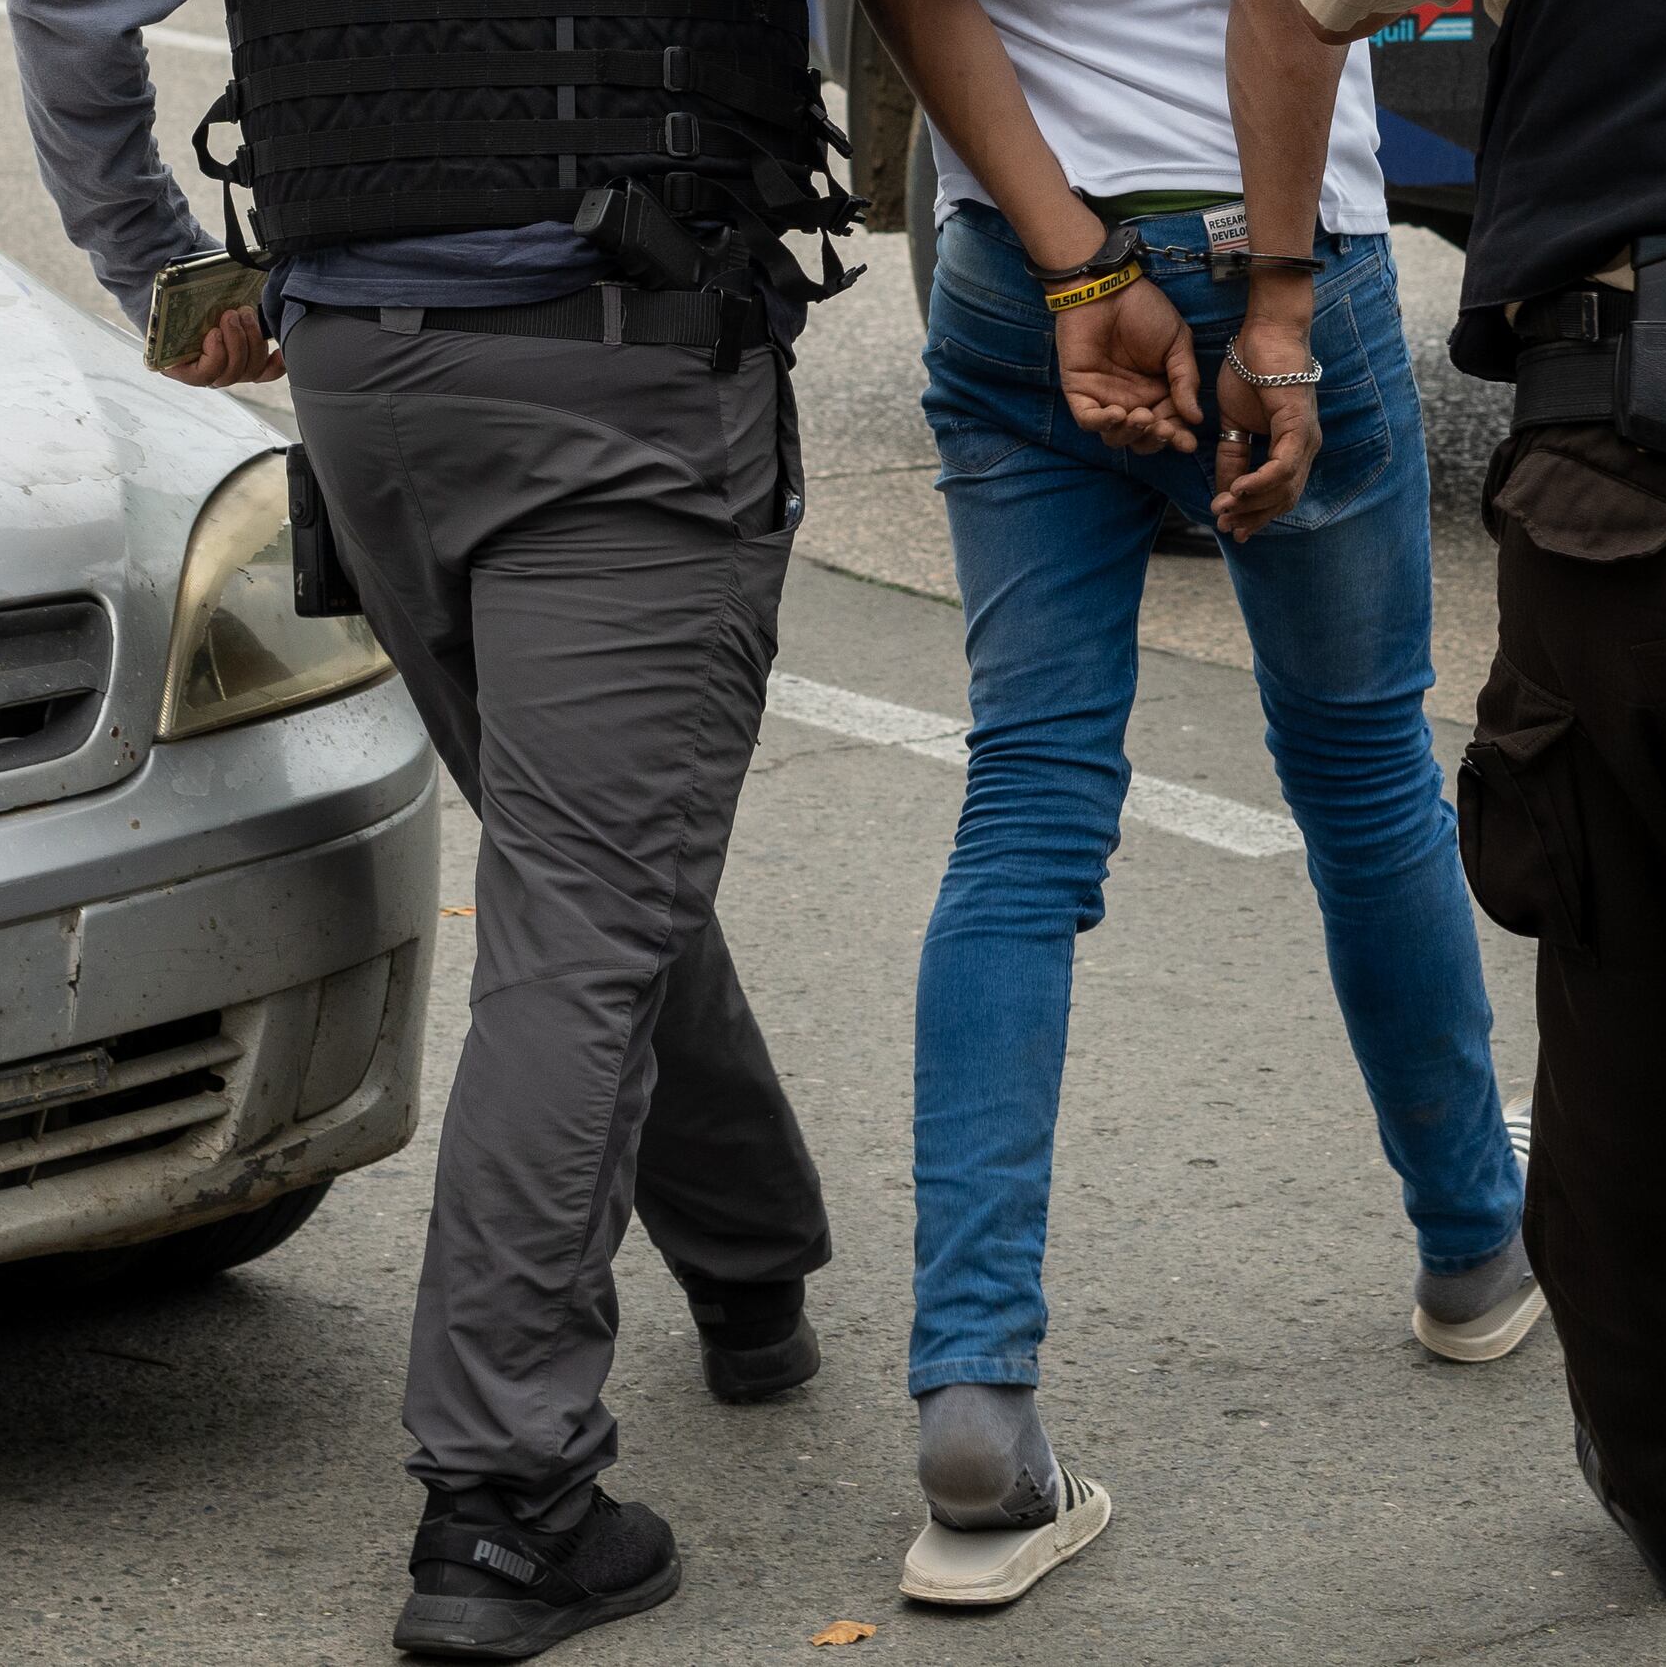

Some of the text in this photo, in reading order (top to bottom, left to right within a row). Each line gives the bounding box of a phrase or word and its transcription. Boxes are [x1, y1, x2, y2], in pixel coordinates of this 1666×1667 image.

[1368, 18, 1415, 48] quil
[1212, 225, 1248, 242] DEVELO
[1059, 286, 1095, 307] SOLO
[473, 1539, 535, 1584] PUMA
